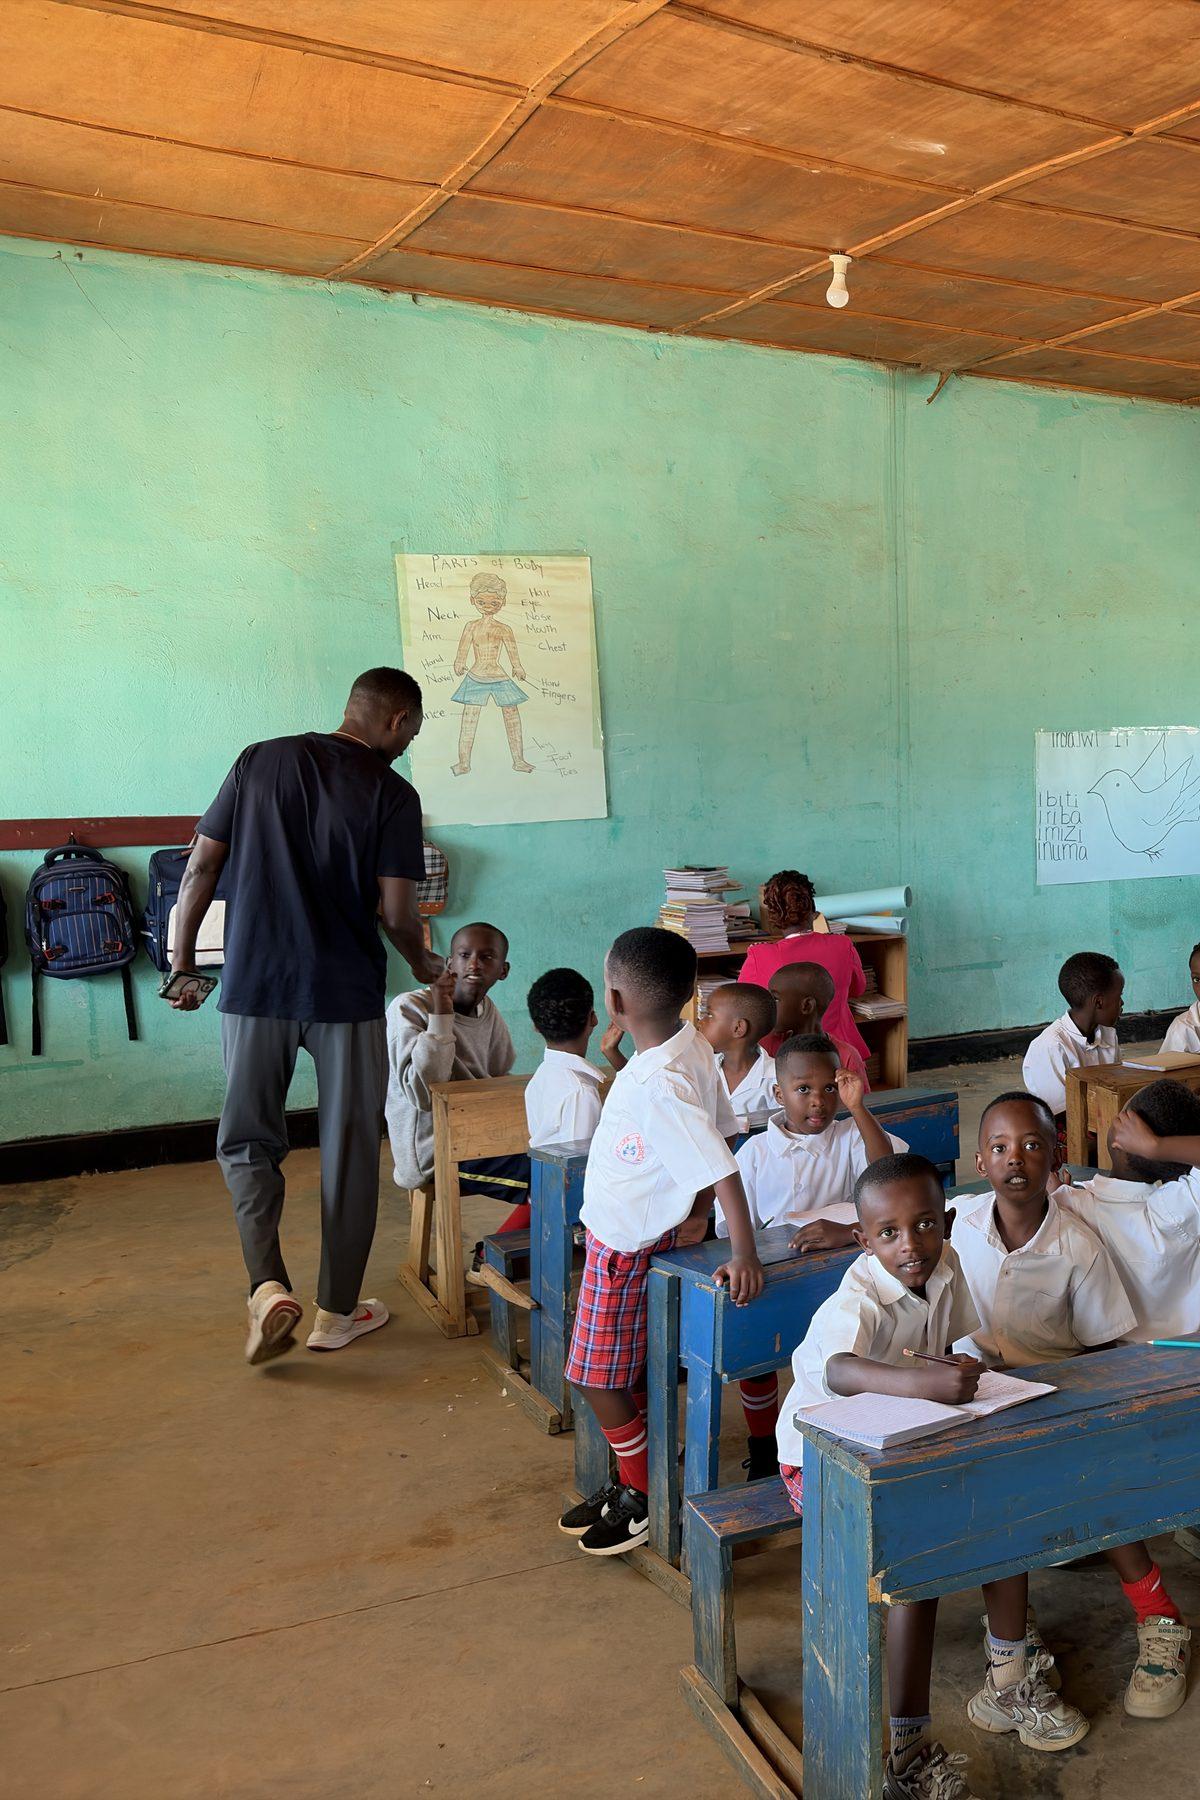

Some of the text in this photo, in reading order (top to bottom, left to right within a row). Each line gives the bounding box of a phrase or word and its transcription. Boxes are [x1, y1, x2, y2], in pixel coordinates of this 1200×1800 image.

[416, 577, 444, 590] Head
[521, 600, 543, 612] Eye
[427, 606, 459, 622] Neck
[525, 611, 552, 621] Nose
[526, 623, 557, 634] Mouth
[421, 630, 442, 641] Arm
[420, 654, 444, 670] Hand
[425, 671, 455, 685] Navel
[541, 688, 577, 705] Fingers
[546, 752, 573, 768] Foot
[991, 1647, 1015, 1657] NIKE
